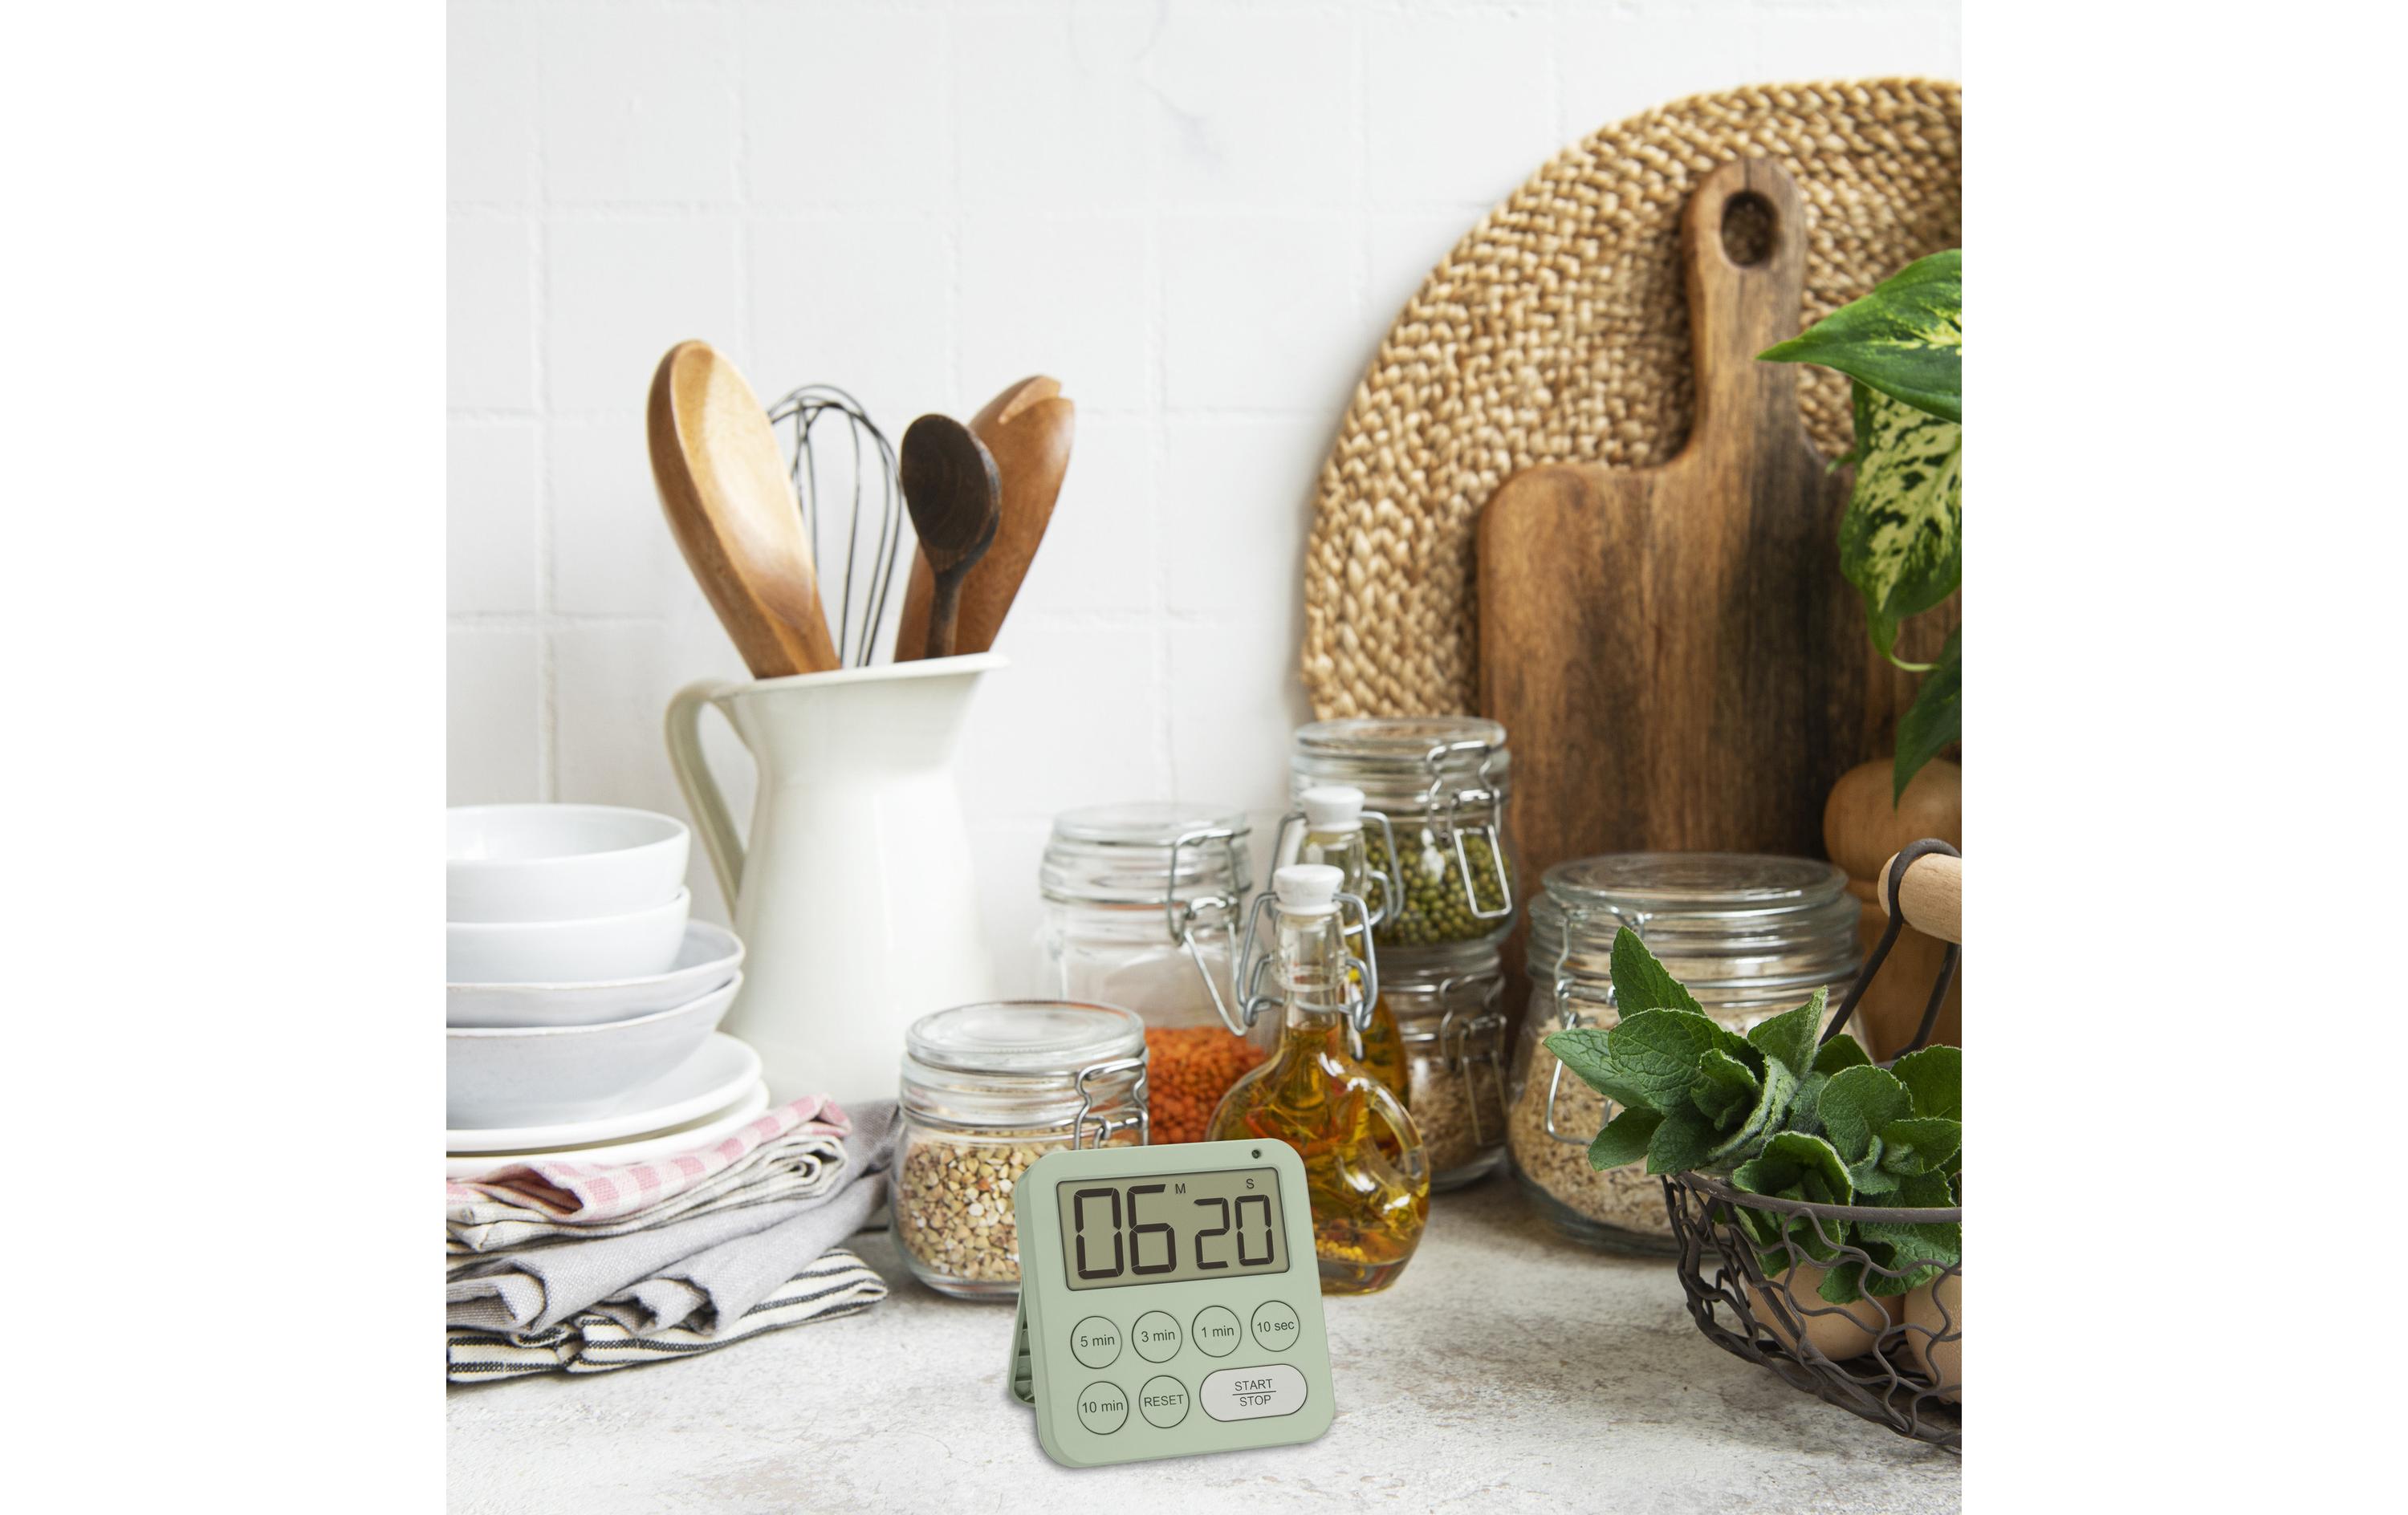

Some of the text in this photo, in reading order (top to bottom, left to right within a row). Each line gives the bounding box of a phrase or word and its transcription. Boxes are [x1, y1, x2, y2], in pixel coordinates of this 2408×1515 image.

[1174, 1183, 1186, 1194] M
[1246, 1178, 1255, 1189] S
[1074, 1184, 1275, 1280] 06 20
[1201, 1325, 1235, 1338] 1 min
[1257, 1320, 1295, 1333] 10 sec
[1080, 1334, 1115, 1348] 5 min
[1141, 1329, 1176, 1342] 3 min
[1235, 1379, 1273, 1391] START
[1082, 1399, 1124, 1413] 10 min
[1144, 1394, 1184, 1407] RESET
[1239, 1395, 1271, 1407] STOP
